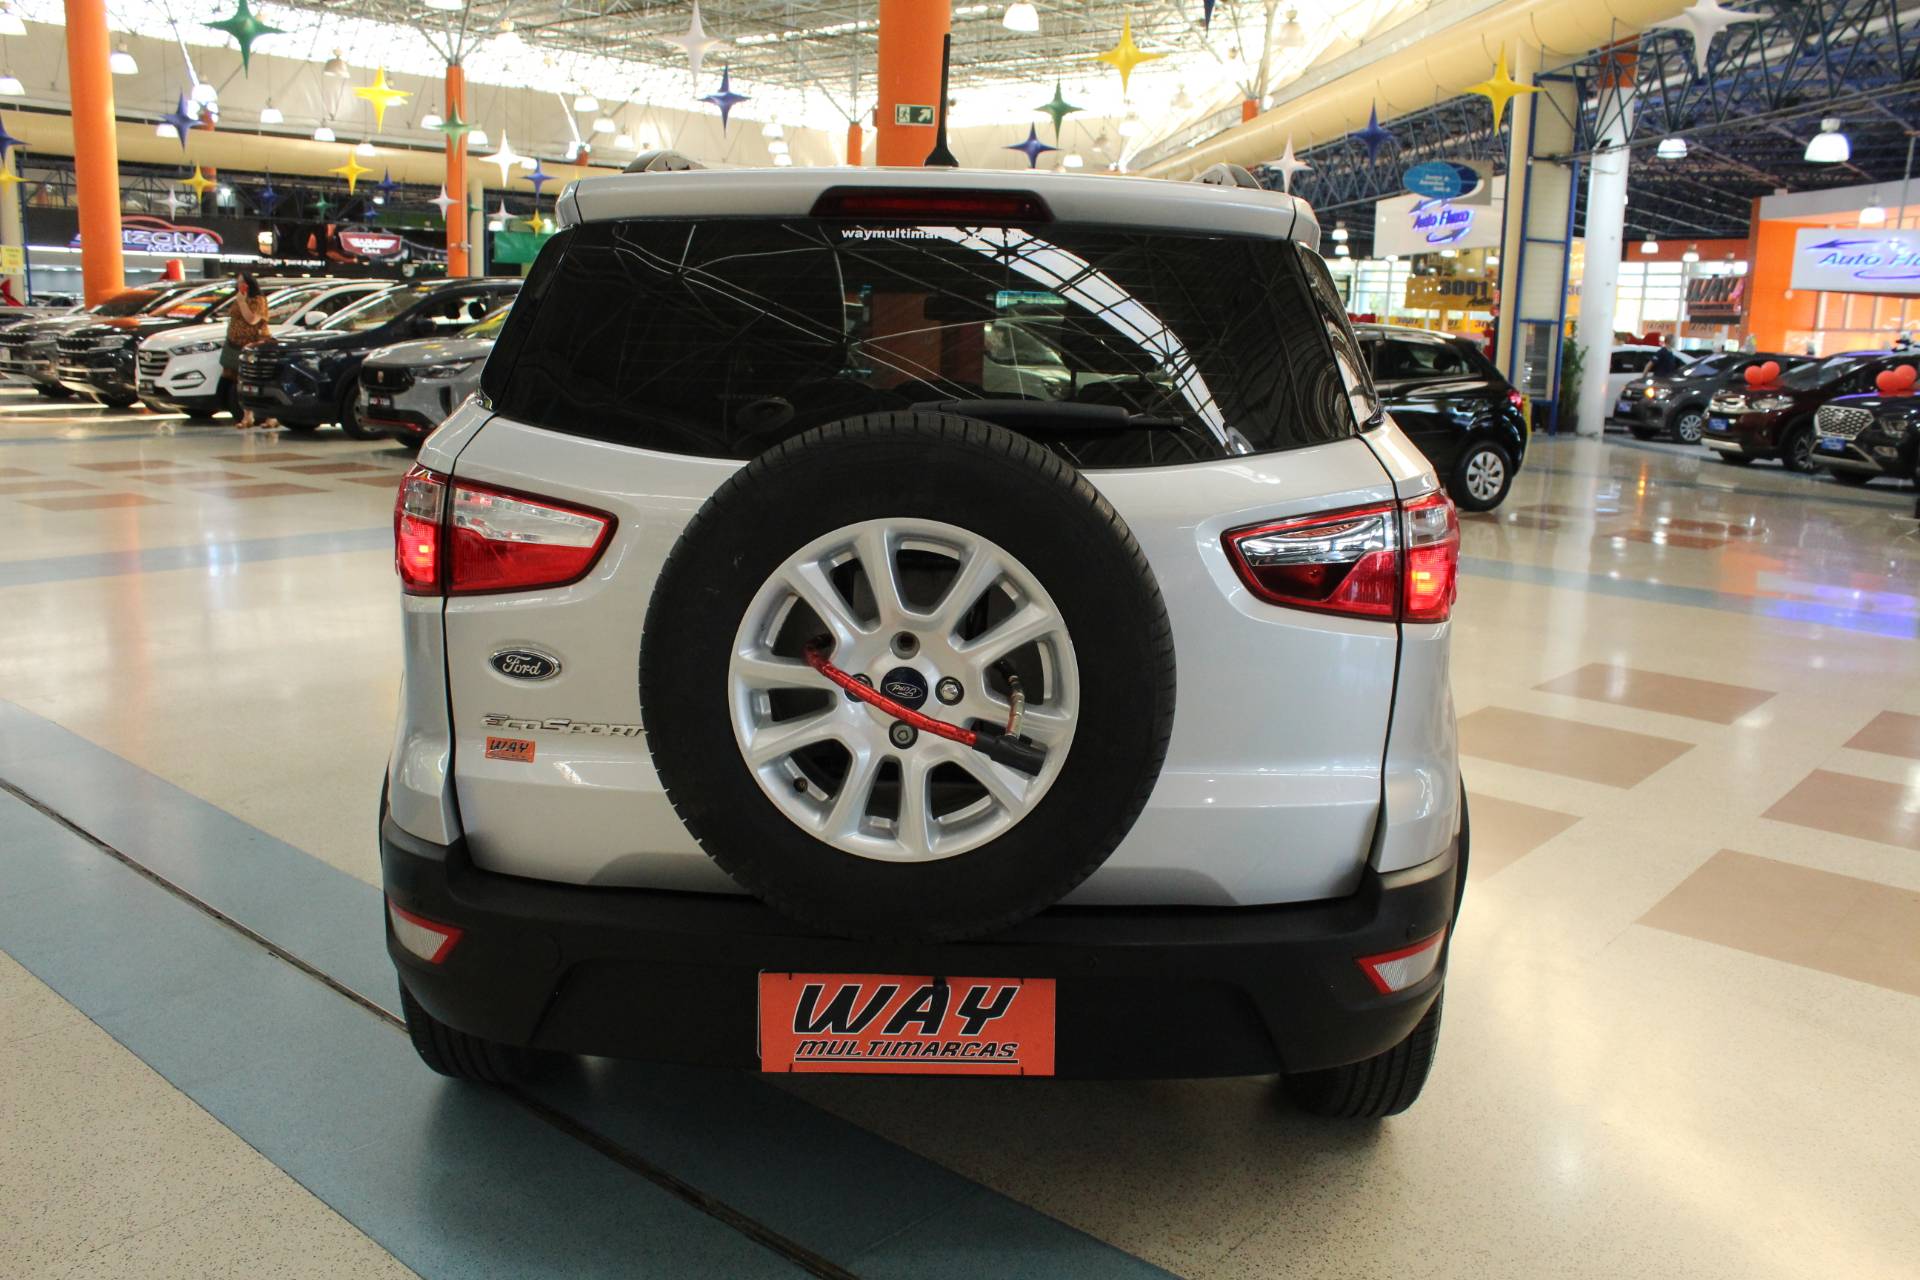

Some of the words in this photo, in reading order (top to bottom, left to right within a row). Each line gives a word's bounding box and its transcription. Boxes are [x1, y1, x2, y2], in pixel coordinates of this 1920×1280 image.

[1818, 252, 1882, 266] Auto
[1438, 279, 1489, 297] 3001
[502, 654, 542, 676] Ford
[490, 739, 529, 753] WAY
[793, 983, 1020, 1036] WAY
[795, 1040, 1020, 1058] MULTIMARCAS
